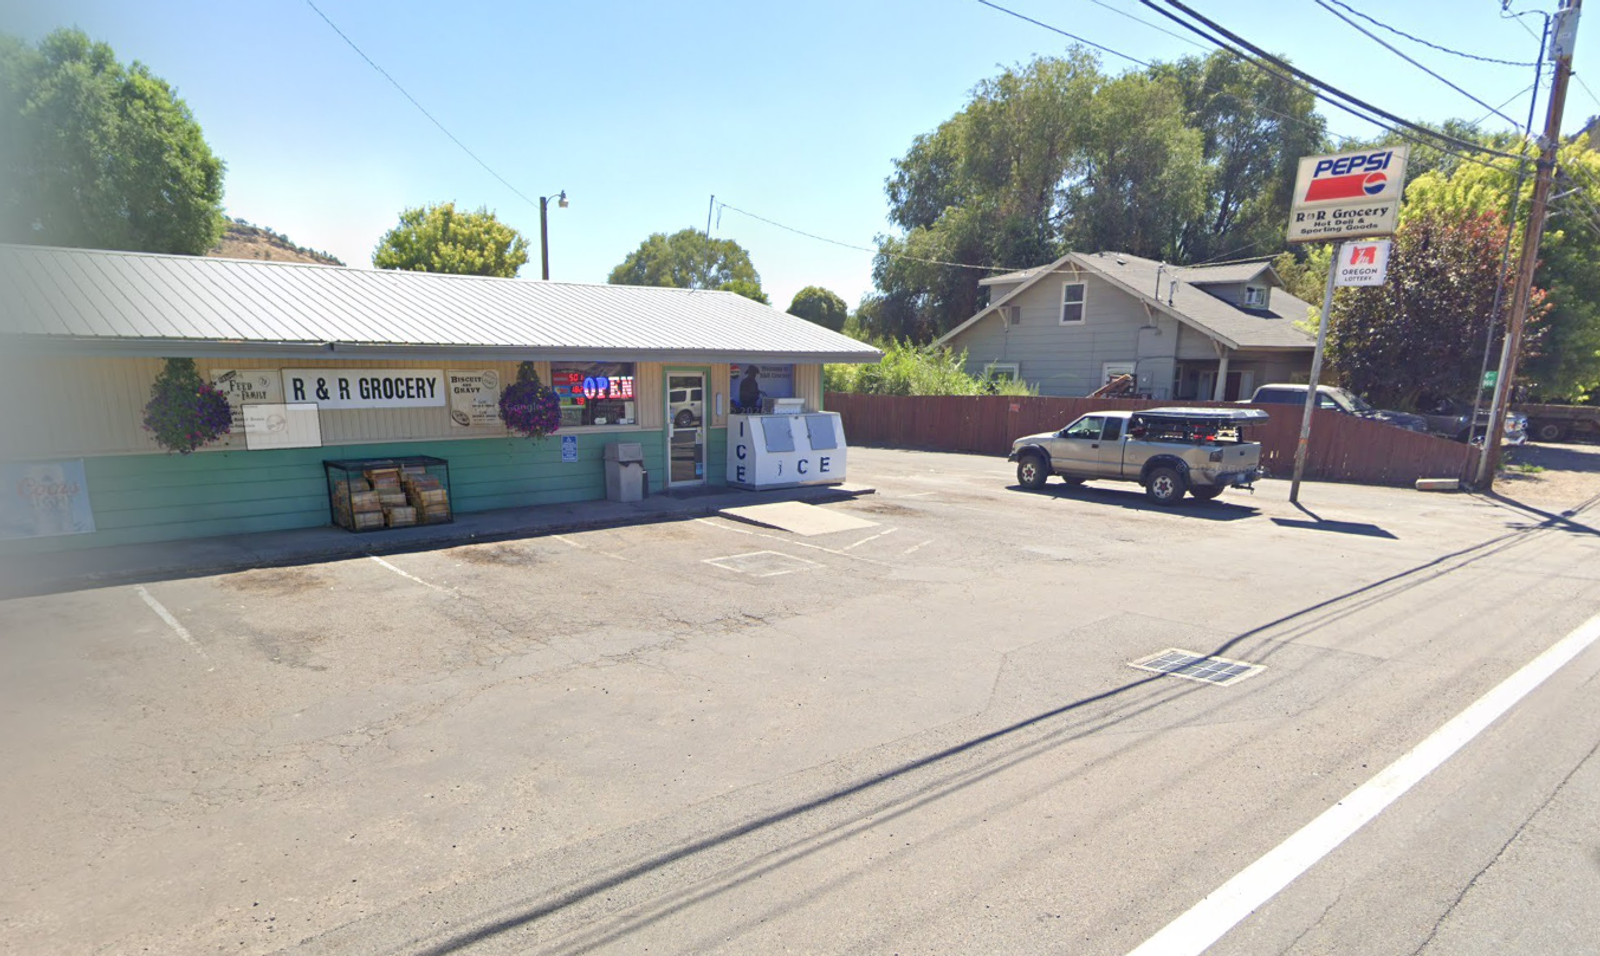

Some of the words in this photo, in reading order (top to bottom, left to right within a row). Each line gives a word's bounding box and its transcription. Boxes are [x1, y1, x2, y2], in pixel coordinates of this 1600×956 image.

[1313, 151, 1394, 178] PEPSI
[1296, 212, 1306, 222] R
[1316, 210, 1326, 220] R
[1333, 207, 1389, 220] Grocery
[1300, 226, 1342, 236] Sporting
[1346, 223, 1378, 231] Goods
[1313, 220, 1331, 228] Hot
[1342, 268, 1377, 276] OREGON
[292, 378, 306, 401] R
[316, 377, 330, 400] &
[338, 378, 351, 400] R
[358, 377, 436, 400] GROCERY
[583, 376, 634, 399] OPEN
